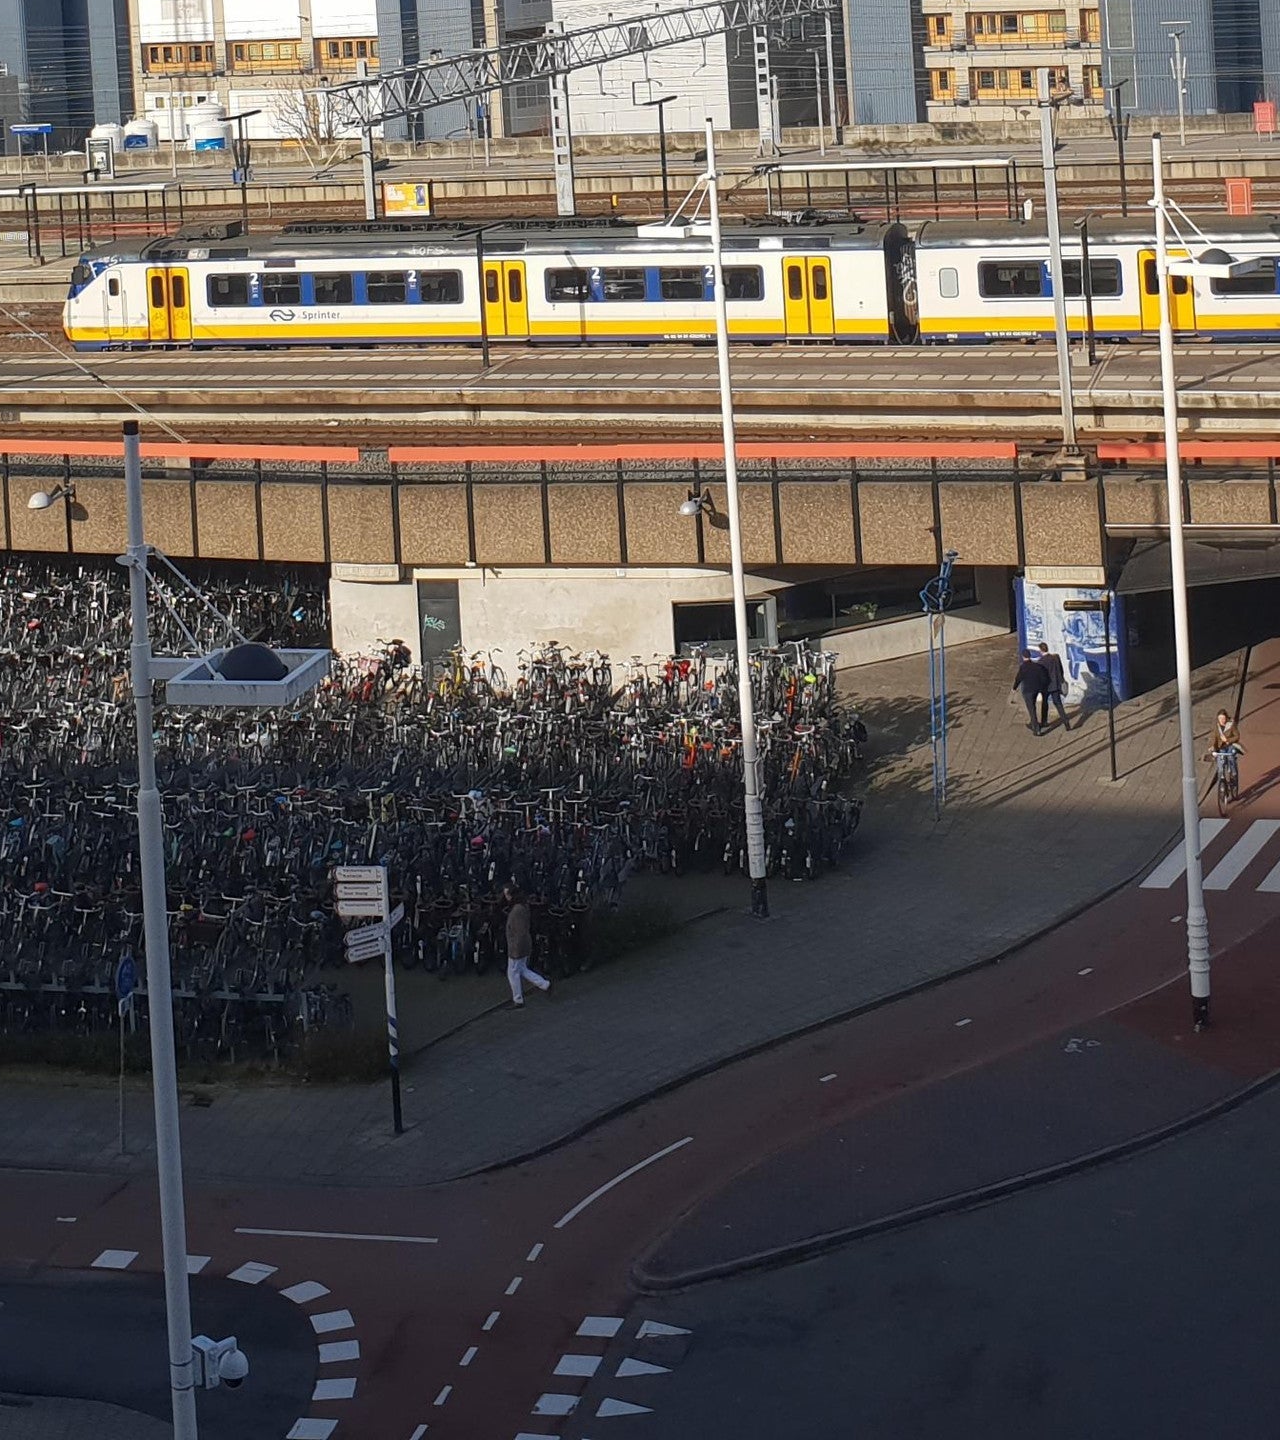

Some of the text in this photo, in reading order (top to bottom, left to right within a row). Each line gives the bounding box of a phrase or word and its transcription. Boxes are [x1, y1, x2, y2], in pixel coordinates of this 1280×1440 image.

[704, 266, 714, 278] 2
[1044, 260, 1051, 272] 1
[249, 273, 258, 285] 2
[407, 270, 417, 282] 2
[591, 268, 600, 279] 2
[302, 311, 340, 320] Sprinter
